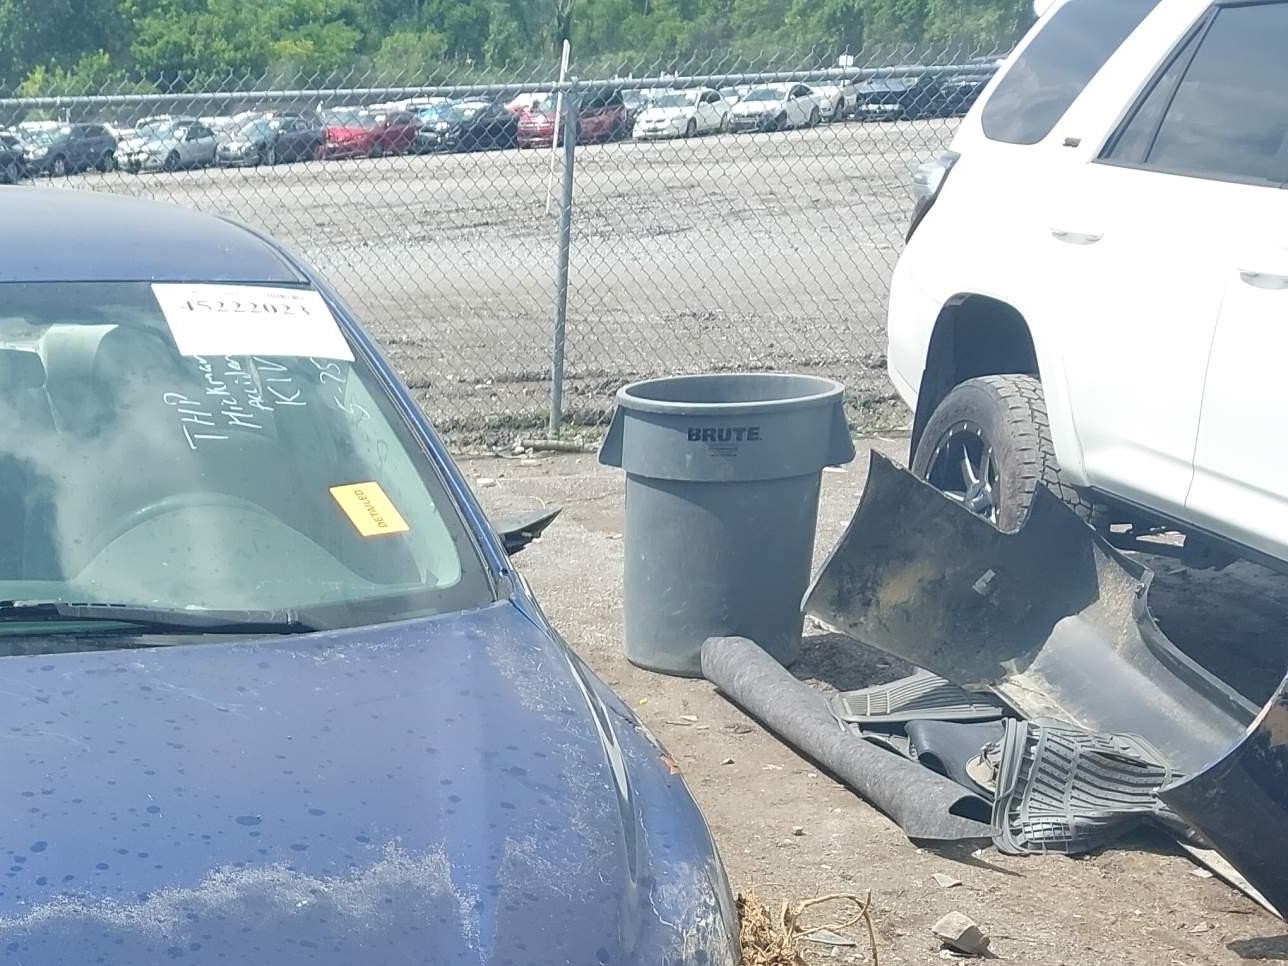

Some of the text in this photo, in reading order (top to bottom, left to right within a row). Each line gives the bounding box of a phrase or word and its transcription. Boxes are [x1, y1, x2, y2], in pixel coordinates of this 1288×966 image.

[163, 391, 230, 450] THP
[687, 426, 761, 442] BRUTE
[353, 489, 389, 528] DETAILED
